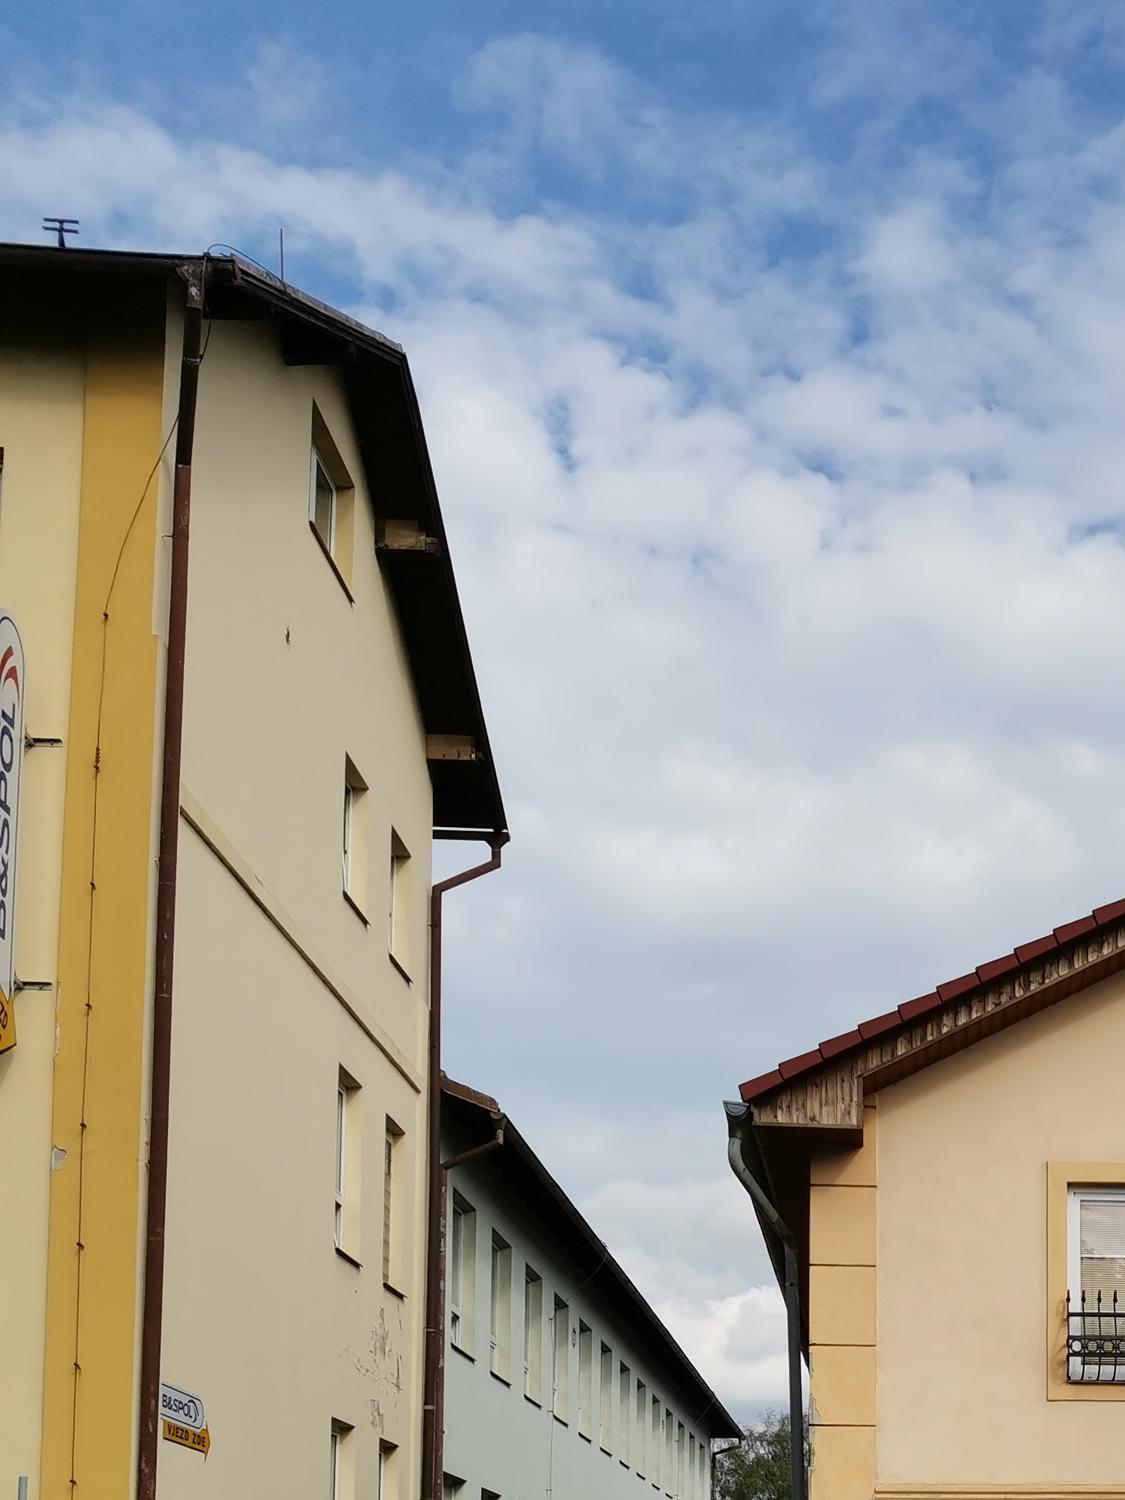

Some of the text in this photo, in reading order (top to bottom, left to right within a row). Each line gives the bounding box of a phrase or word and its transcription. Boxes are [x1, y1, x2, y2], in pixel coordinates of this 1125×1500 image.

[162, 1394, 193, 1419] B&SPOL
[167, 1423, 206, 1448] VJEZD ZDE
